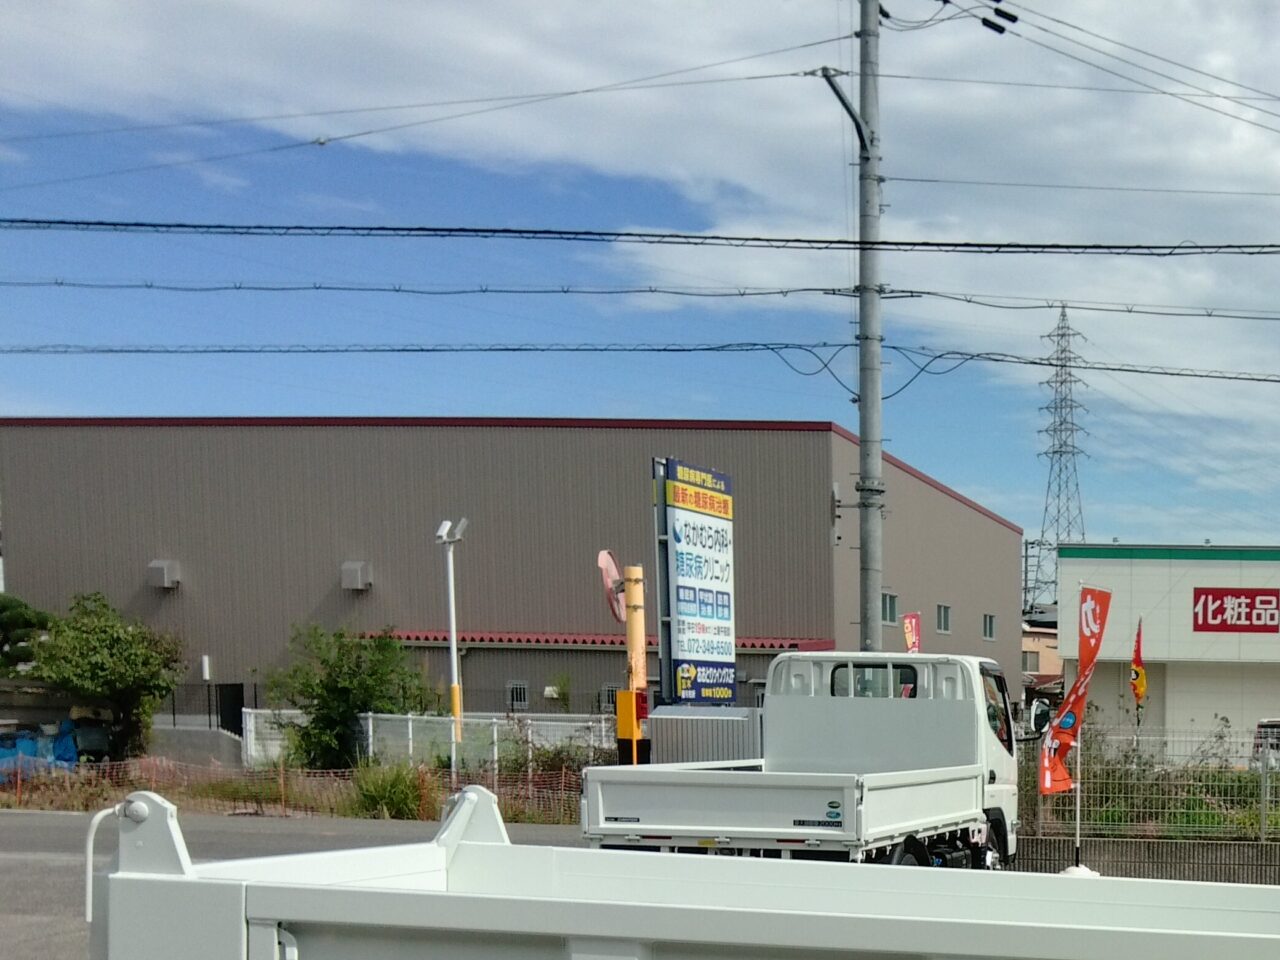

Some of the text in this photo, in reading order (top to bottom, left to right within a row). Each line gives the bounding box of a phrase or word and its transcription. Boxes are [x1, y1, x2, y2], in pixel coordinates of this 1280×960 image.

[675, 550, 730, 583] 糖尿病クリニック
[1194, 595, 1279, 626] 化粧品
